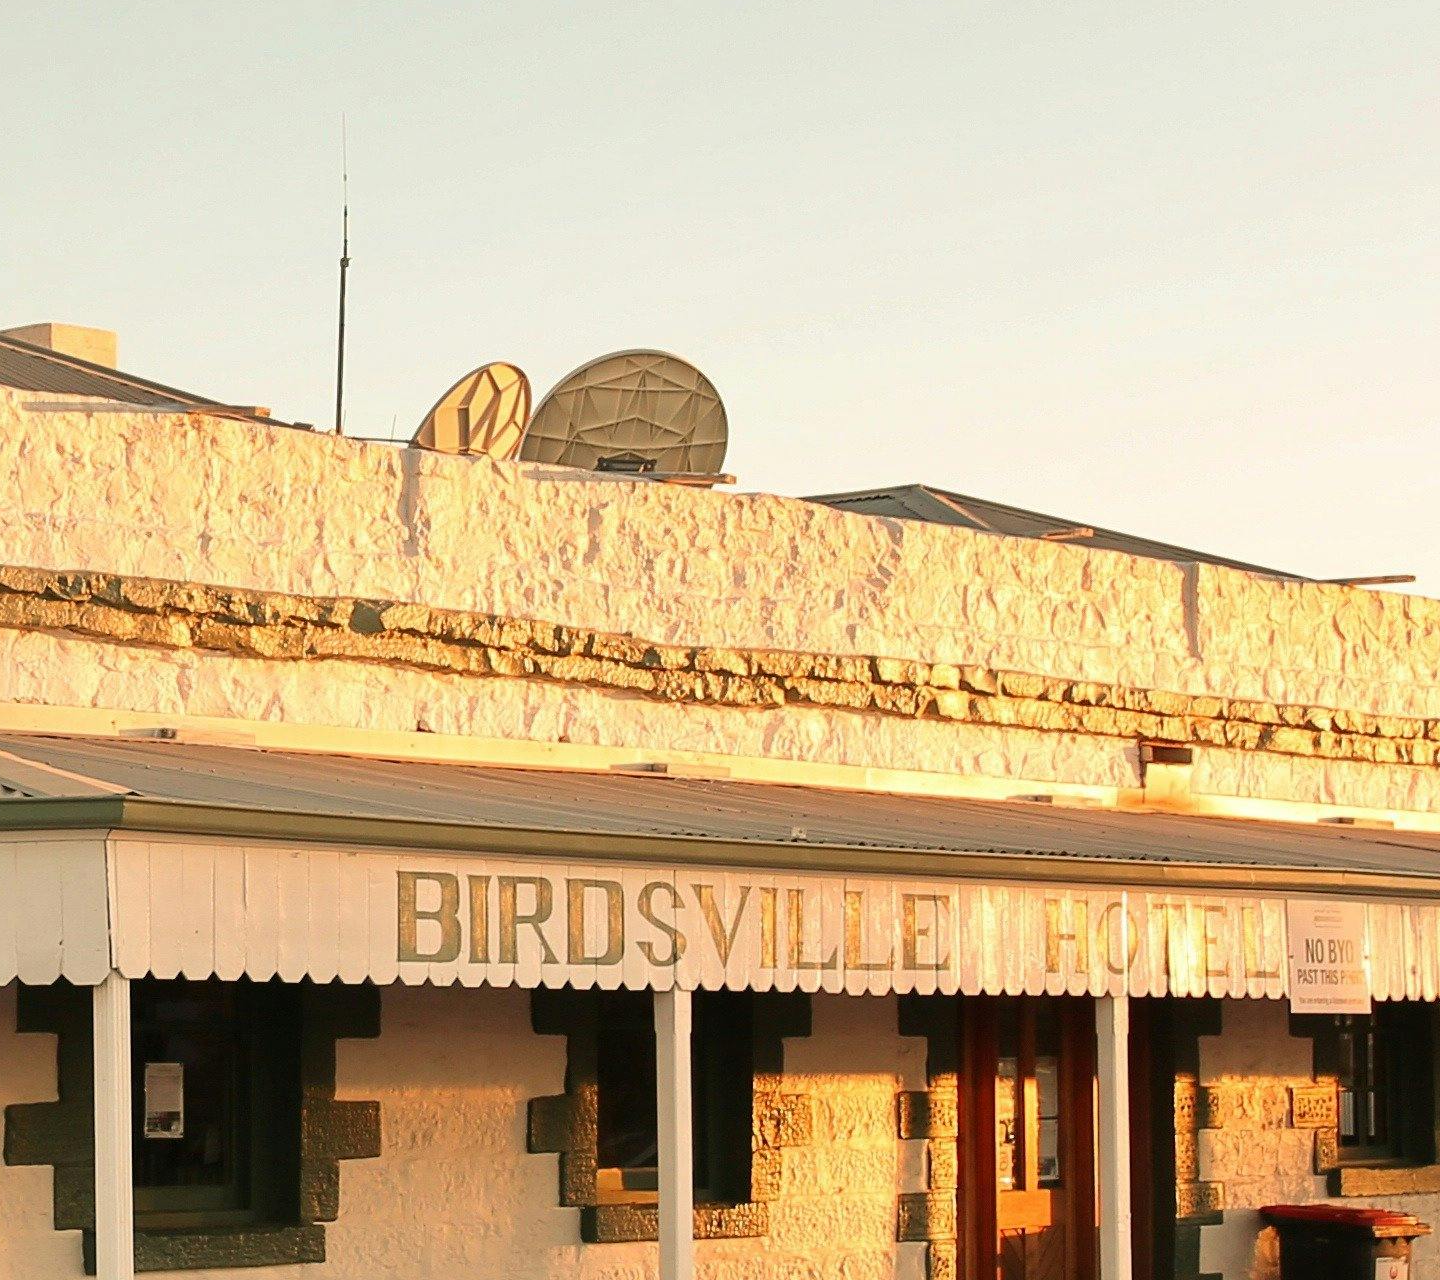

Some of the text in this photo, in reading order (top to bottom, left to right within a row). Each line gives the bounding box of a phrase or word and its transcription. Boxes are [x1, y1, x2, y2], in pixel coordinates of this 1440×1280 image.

[397, 870, 1280, 979] BIRDSVILLE HOTEL
[1305, 938, 1354, 964] NO BYO
[1297, 968, 1318, 984] PAST
[1320, 969, 1339, 985] THIS
